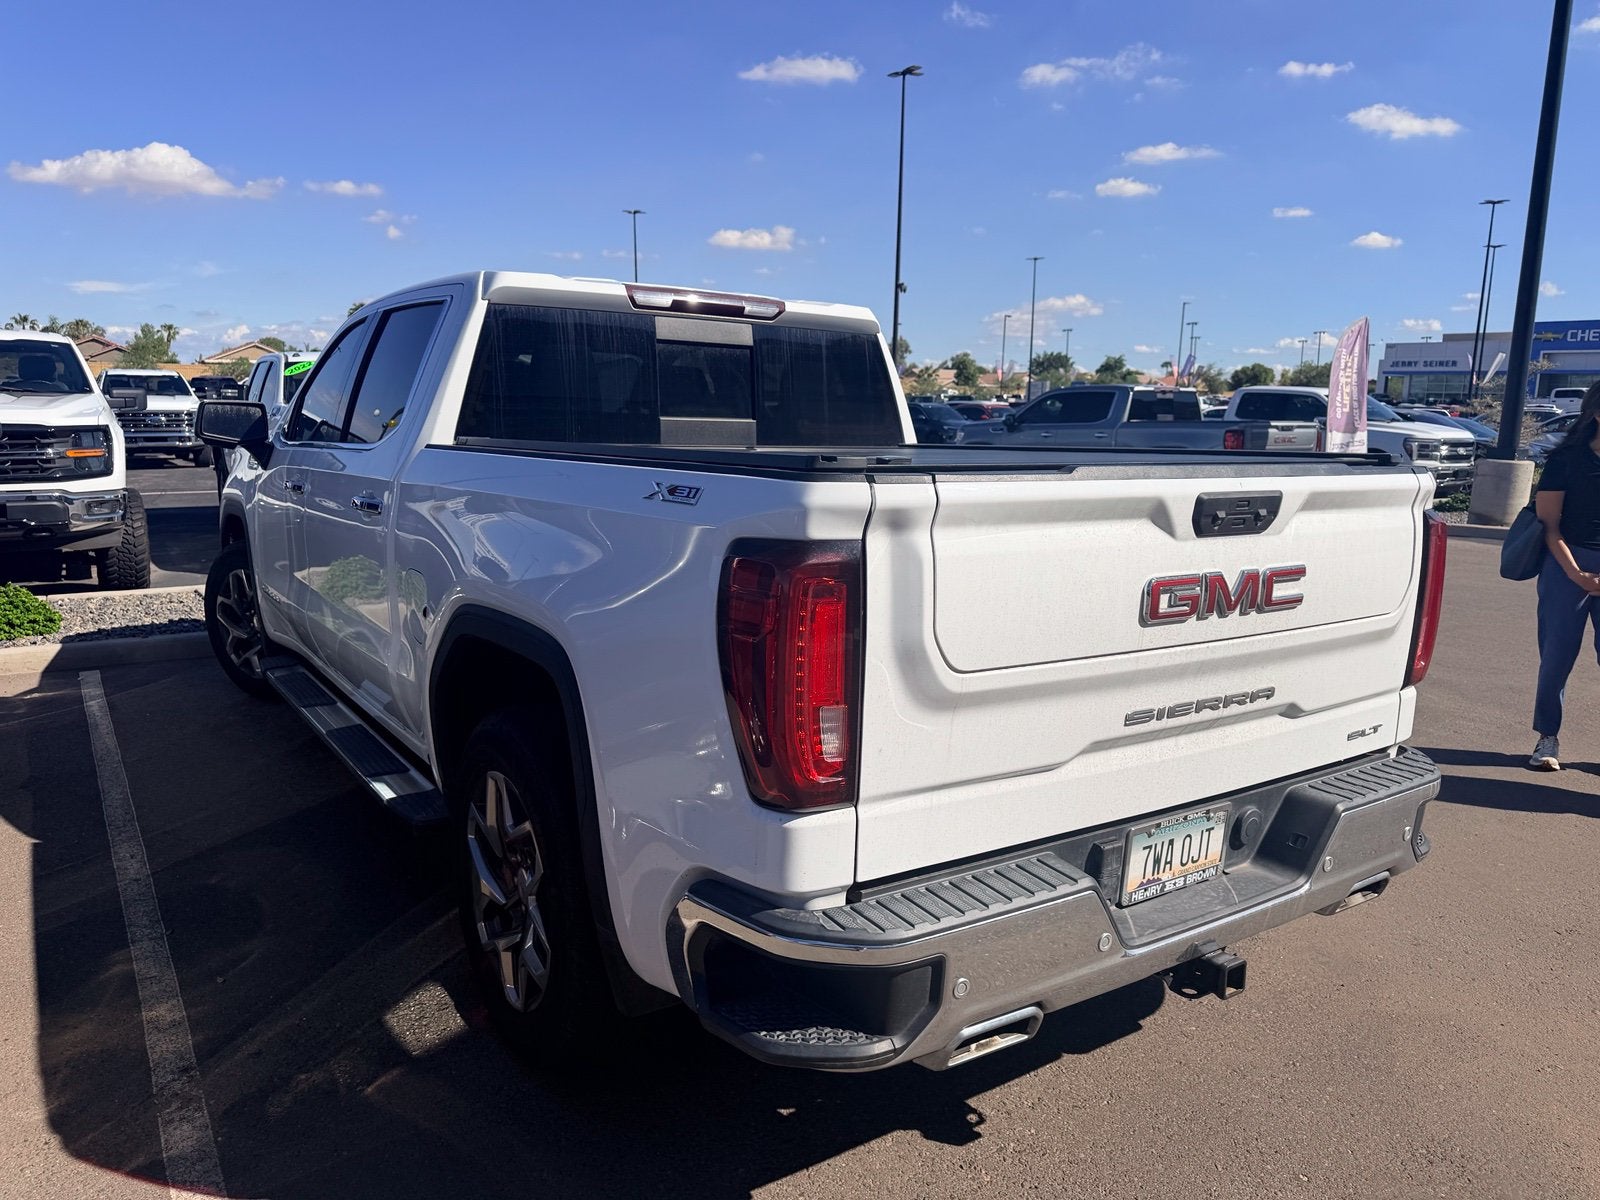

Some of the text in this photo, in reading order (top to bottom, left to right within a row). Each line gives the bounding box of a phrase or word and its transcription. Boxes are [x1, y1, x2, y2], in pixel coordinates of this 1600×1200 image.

[1566, 328, 1600, 342] CHE
[1390, 360, 1458, 369] JERRY SEINER
[1336, 408, 1342, 419] GO
[642, 481, 704, 506] X31
[1139, 564, 1306, 628] GMC
[1123, 686, 1276, 727] SIERRA
[1347, 723, 1384, 741] SLT
[1160, 816, 1184, 828] BUICK
[1187, 810, 1207, 821] GMC
[1142, 838, 1175, 879] 7WA
[1131, 883, 1162, 902] HENRY
[1186, 866, 1217, 884] BROWN
